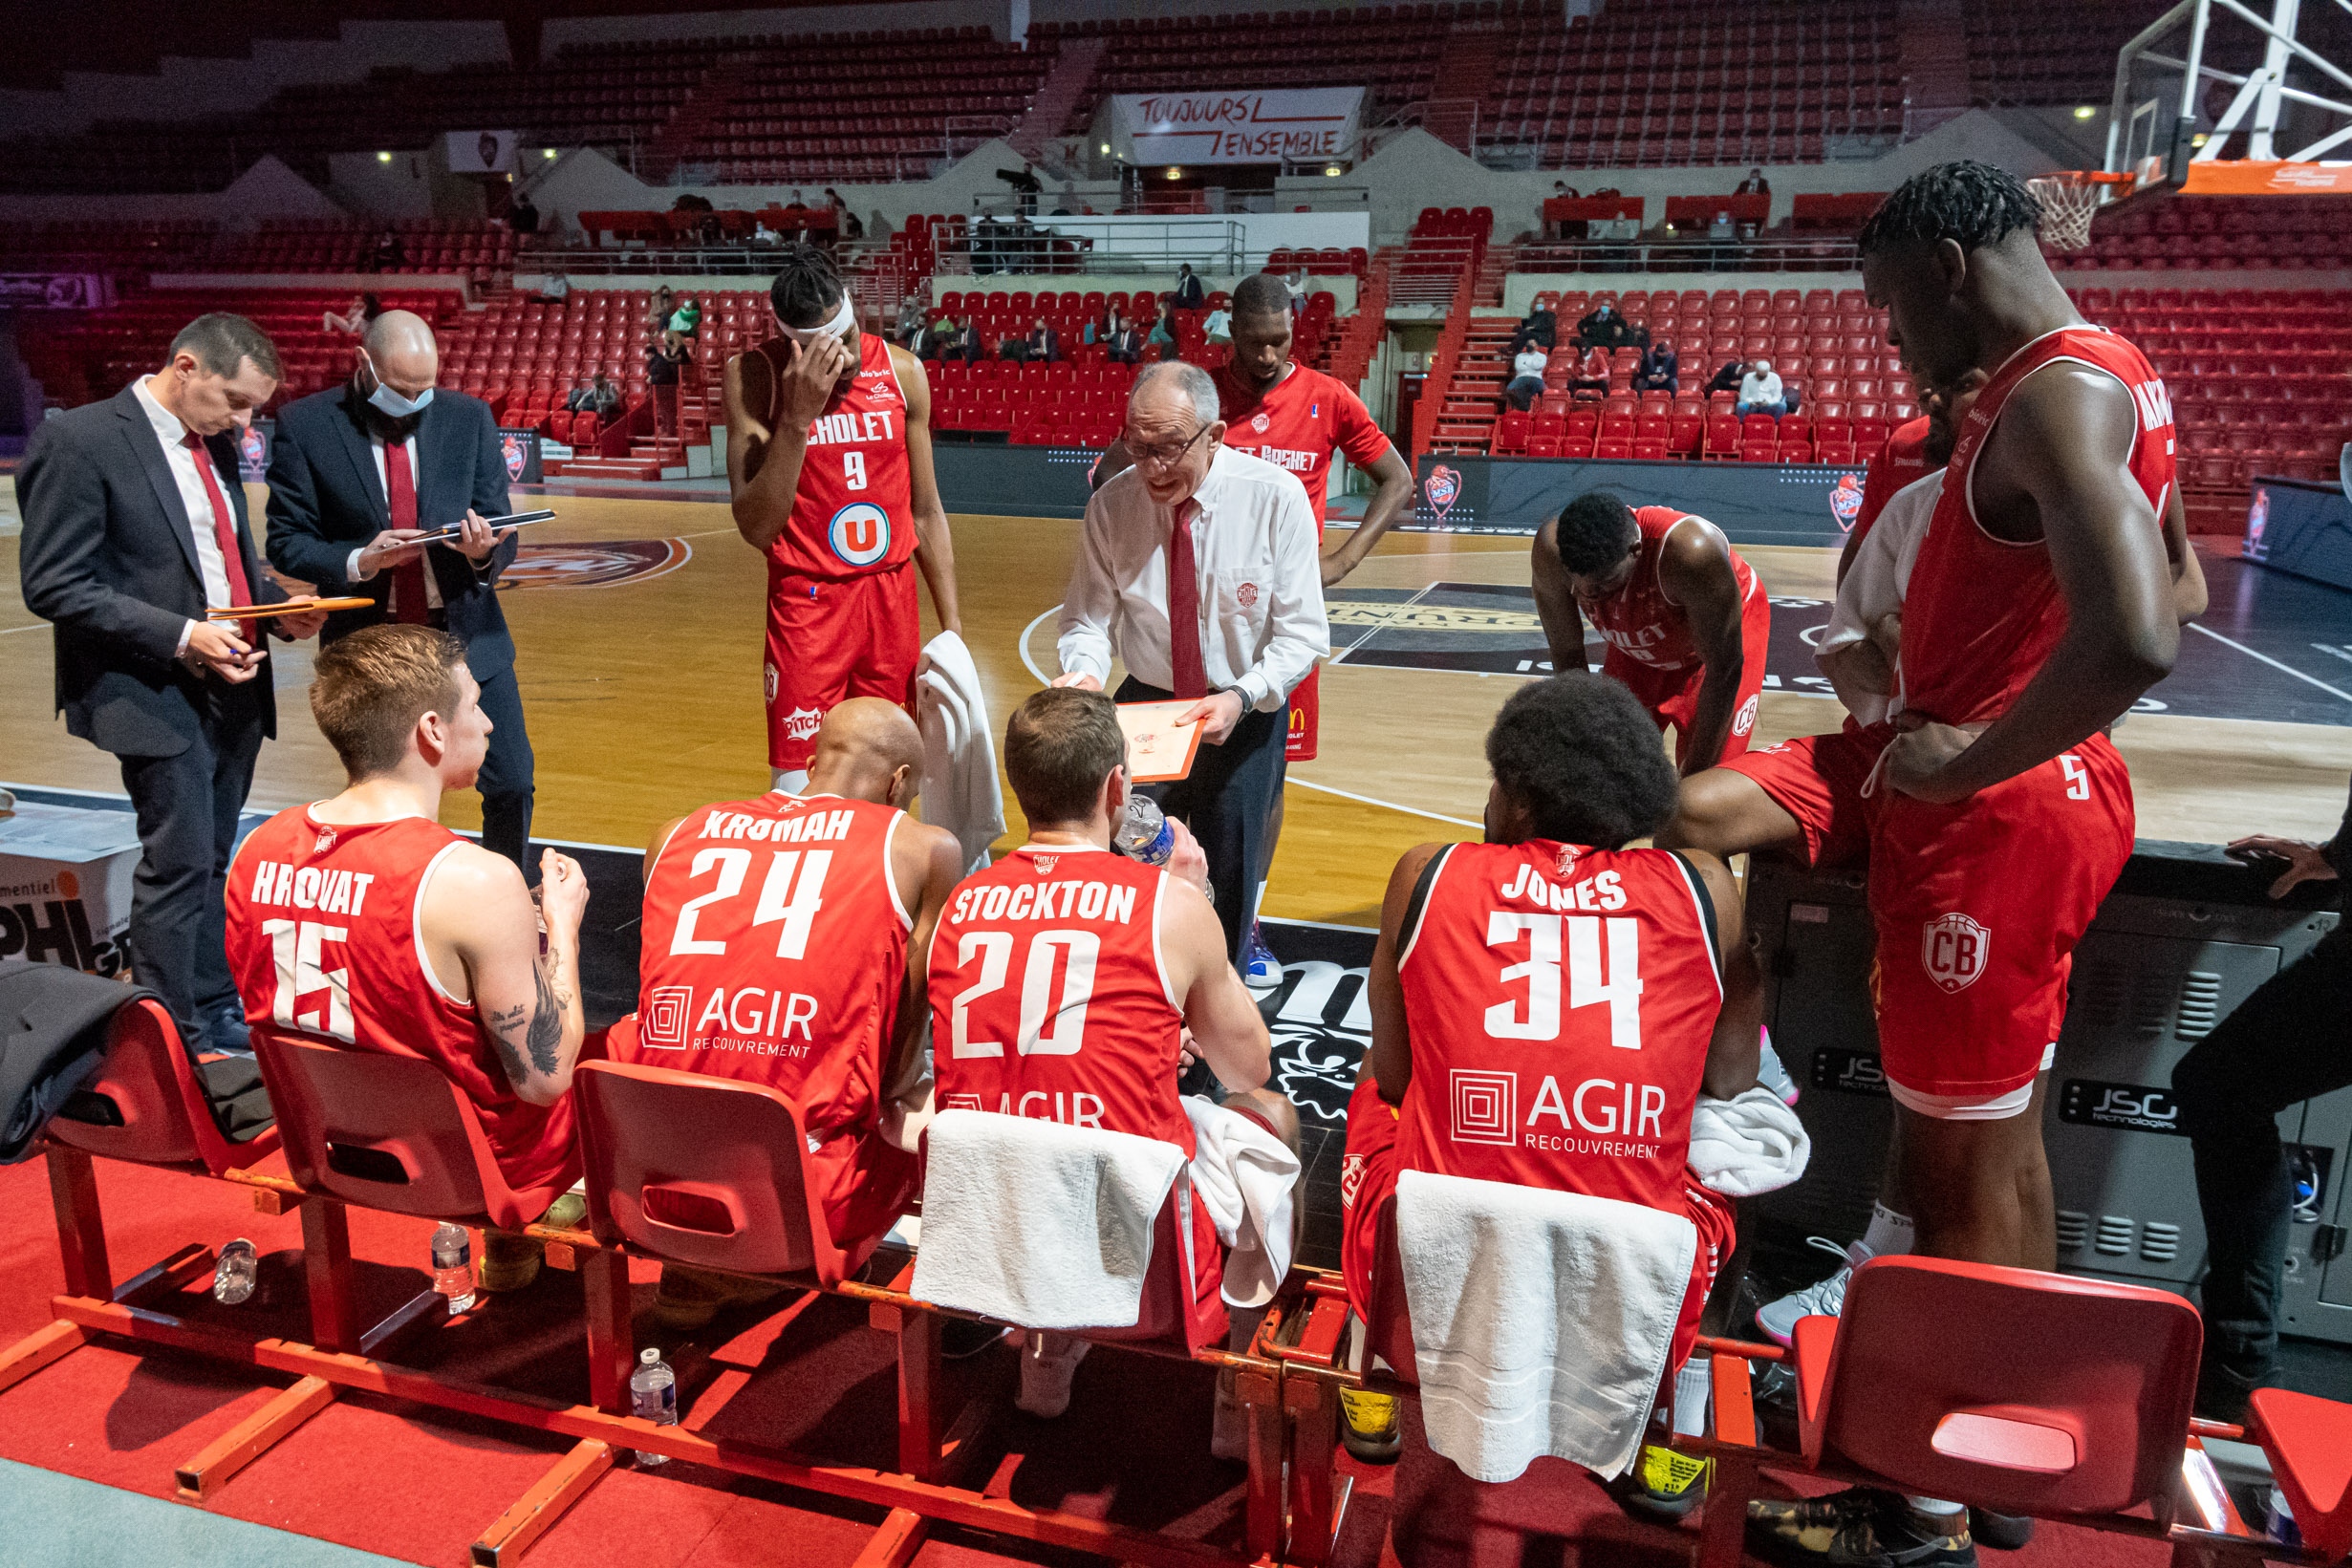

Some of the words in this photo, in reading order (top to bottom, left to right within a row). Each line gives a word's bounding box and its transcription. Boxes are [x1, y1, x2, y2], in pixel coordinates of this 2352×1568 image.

[1139, 95, 1251, 126] TOUJOURS
[1225, 130, 1339, 157] ENSEMBLE
[843, 451, 868, 492] 9
[1262, 445, 1319, 472] BASKET
[1432, 484, 1455, 498] MSB
[844, 519, 877, 552] U
[1737, 702, 1756, 732] CB
[2059, 754, 2091, 801] 5
[698, 810, 855, 843] KROMAH
[1129, 797, 1146, 819] 20
[250, 860, 375, 916] HROVAT
[669, 847, 834, 960] 24
[950, 880, 1137, 925] STOCKTON
[1500, 863, 1629, 912] JONES
[1931, 931, 1976, 977] CB
[262, 918, 356, 1045] 15
[952, 929, 1101, 1060] 20
[1483, 911, 1643, 1050] 34
[696, 987, 818, 1042] AGIR
[693, 1037, 810, 1059] RECOUVREMENT
[1526, 1075, 1667, 1139] AGIR
[2092, 1112, 2177, 1129] technologies
[1526, 1133, 1661, 1161] RECOUVREMENT
